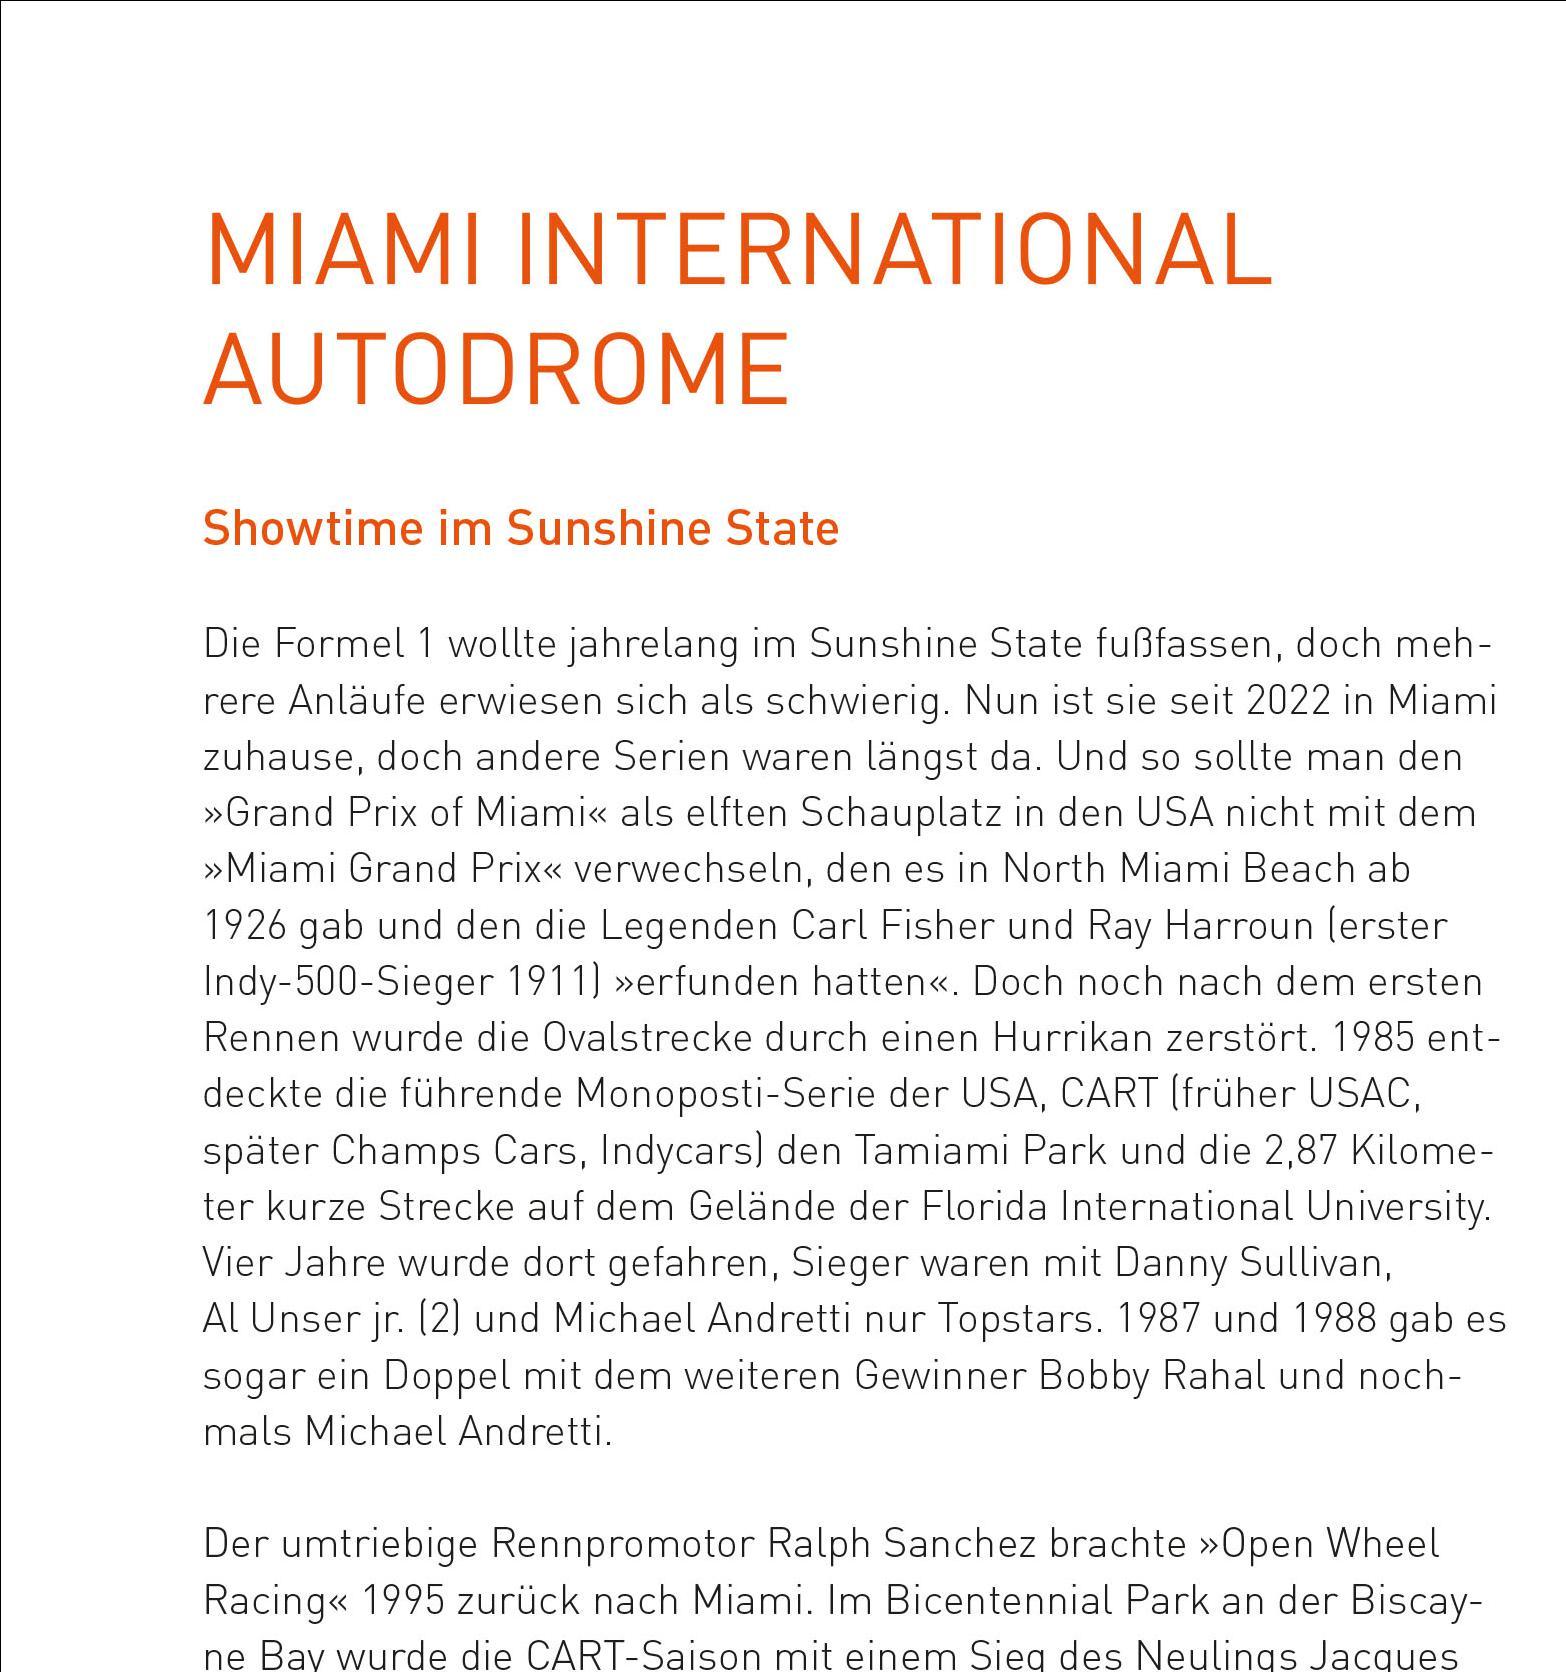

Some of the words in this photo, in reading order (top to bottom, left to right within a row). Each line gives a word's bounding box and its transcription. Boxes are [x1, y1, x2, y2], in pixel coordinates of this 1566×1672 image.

[211, 211, 477, 286] MIAMI
[521, 211, 1273, 286] INTERNATIONAL
[202, 331, 788, 406] AUTODROME
[203, 508, 423, 546] Showtime
[439, 508, 491, 546] im
[507, 508, 711, 546] Sunshine
[726, 508, 839, 546] State
[205, 626, 260, 658] Die
[276, 626, 405, 658] Formel
[419, 626, 429, 658] 1
[448, 626, 556, 658] wollte
[566, 626, 737, 668] jahrelang
[753, 626, 795, 658] im
[810, 626, 977, 658] Sunshine
[991, 626, 1082, 658] State
[1096, 626, 1282, 664] fußfassen,
[1296, 626, 1380, 658] doch
[1397, 626, 1492, 658] meh-
[205, 964, 495, 1006] Indy-500-Sieger
[509, 960, 599, 1000] 1911)
[615, 964, 797, 996] »erfunden
[814, 964, 958, 996] hatten«.
[975, 964, 1062, 996] Doch
[1079, 964, 1163, 996] noch
[1179, 964, 1261, 996] nach
[1276, 964, 1354, 996] dem
[1369, 967, 1481, 996] ersten
